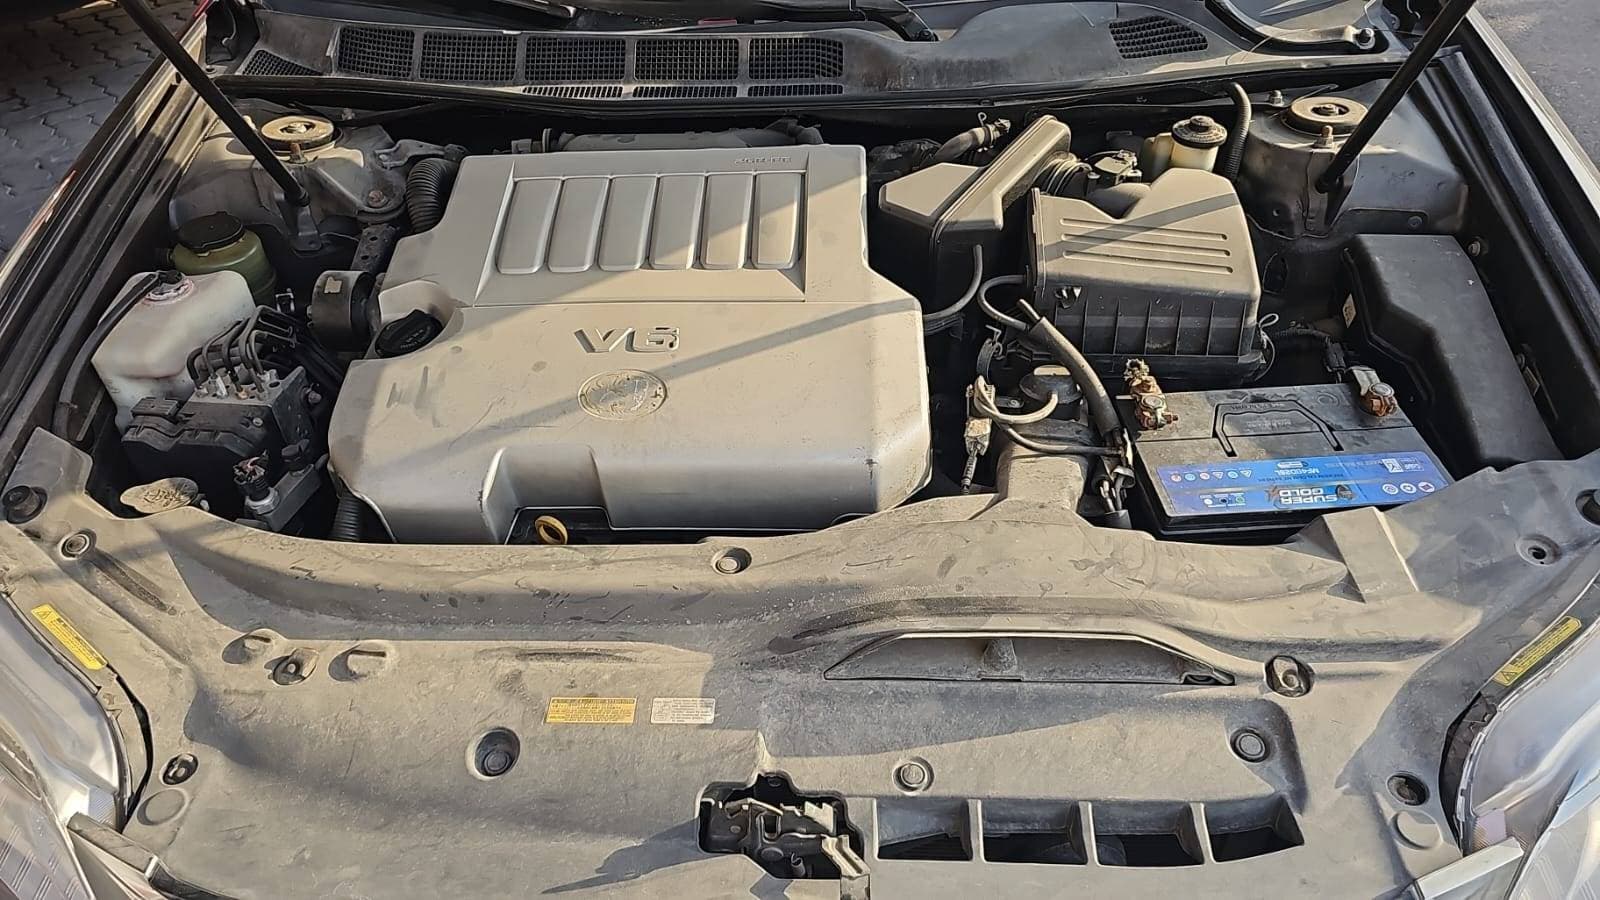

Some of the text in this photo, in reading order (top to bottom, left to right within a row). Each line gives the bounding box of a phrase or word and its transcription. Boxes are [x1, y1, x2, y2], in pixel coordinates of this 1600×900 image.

[573, 326, 680, 354] V6
[1279, 487, 1324, 497] GOLD
[1280, 494, 1339, 505] SUPER
